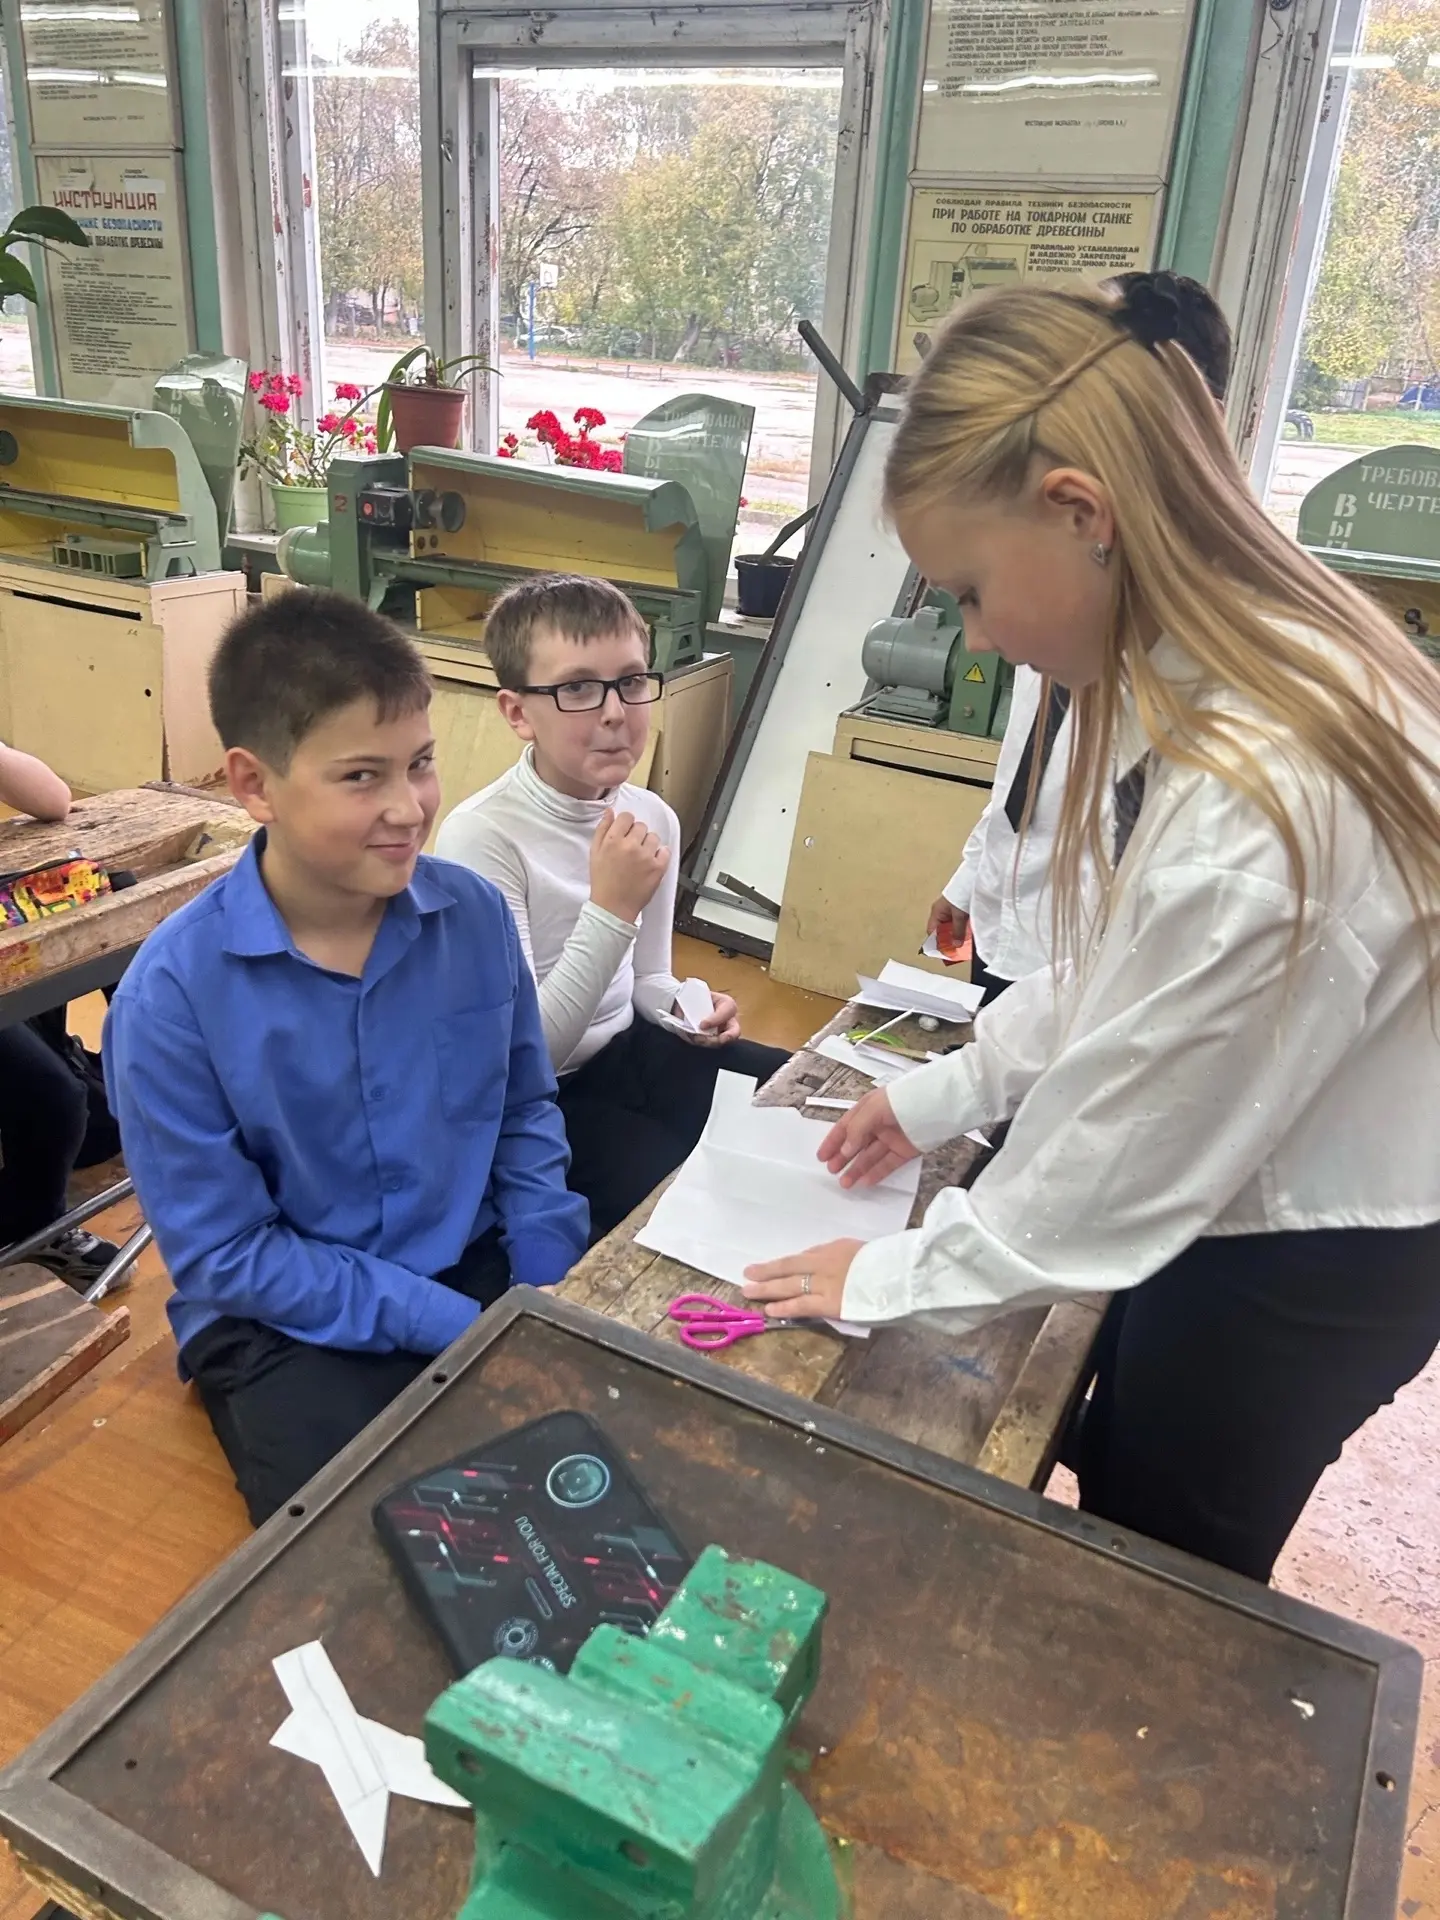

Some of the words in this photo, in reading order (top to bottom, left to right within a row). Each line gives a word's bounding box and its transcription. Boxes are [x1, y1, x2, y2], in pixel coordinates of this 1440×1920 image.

[1068, 201, 1132, 209] БЕЗОПАСНОСТИ
[932, 208, 955, 219] ПРИ
[960, 209, 1001, 221] РАБОТЕ
[1006, 211, 1021, 221] НА
[1027, 211, 1087, 223] ТОКАРНОМ
[1092, 212, 1133, 225] СТАНКЕ
[951, 222, 967, 233] ПО
[971, 223, 1032, 235] ОБРАБОТКЕ
[1036, 224, 1106, 238] ДРЕВЕСИНЫ
[1030, 244, 1075, 252] ПРАВИЛЬНО
[1361, 465, 1440, 488] ТРЕБОВ
[334, 494, 348, 512] 2
[514, 1515, 536, 1541] YOU
[528, 1538, 550, 1564] FOR
[542, 1559, 577, 1609] SPECIAL
